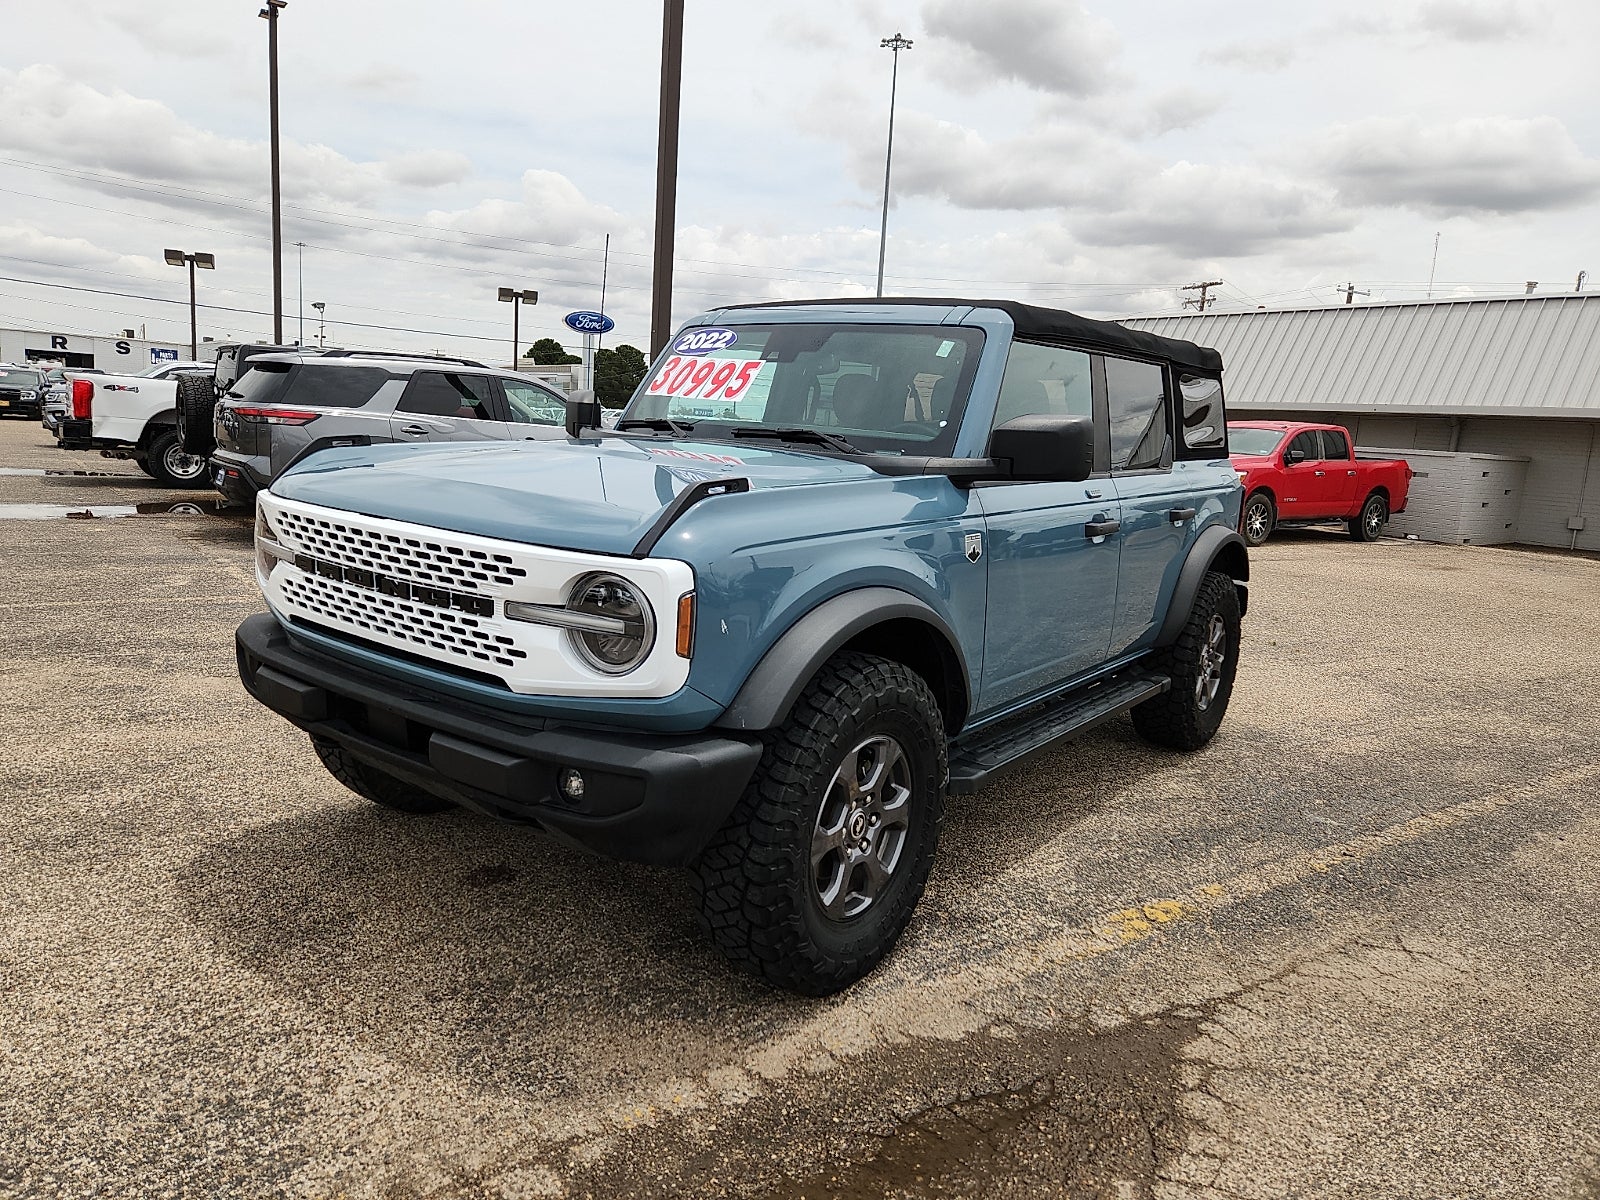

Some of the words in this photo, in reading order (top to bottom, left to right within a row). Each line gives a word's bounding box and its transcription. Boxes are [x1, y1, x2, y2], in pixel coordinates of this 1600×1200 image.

[576, 314, 605, 330] Ford
[51, 335, 68, 349] R
[115, 341, 131, 355] S
[680, 331, 728, 350] 2022
[650, 356, 762, 399] 30995
[294, 553, 495, 618] BRONCO
